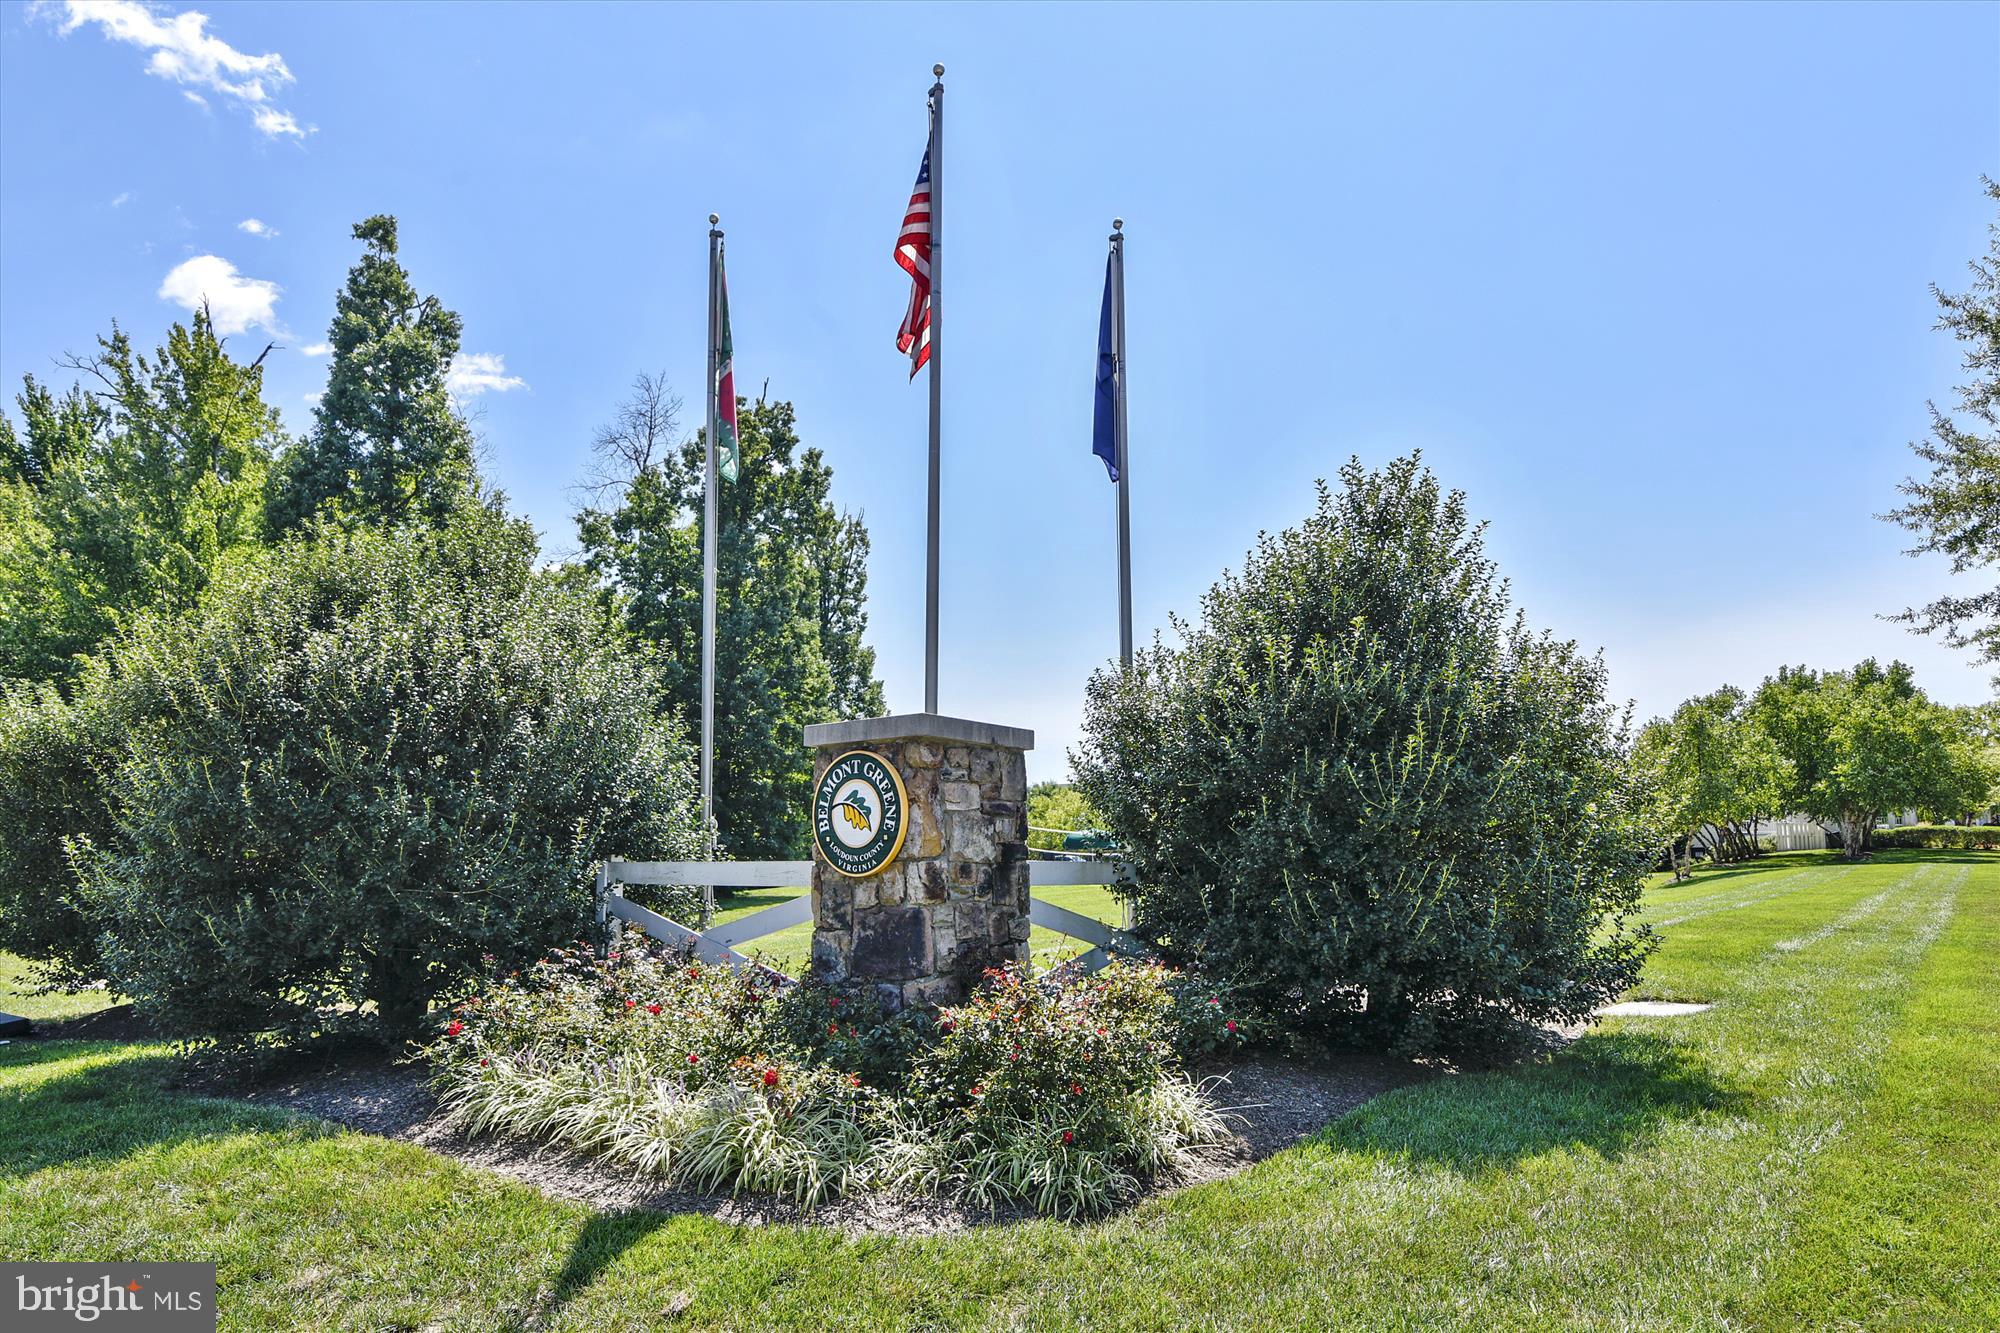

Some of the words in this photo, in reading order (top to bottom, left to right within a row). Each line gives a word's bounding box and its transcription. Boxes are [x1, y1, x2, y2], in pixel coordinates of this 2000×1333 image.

[818, 759, 861, 833] BELMONT
[863, 761, 897, 832] GREENE
[829, 841, 859, 862] LOUDOUN
[859, 839, 885, 862] COUNTY
[838, 859, 877, 872] VIRGINIA
